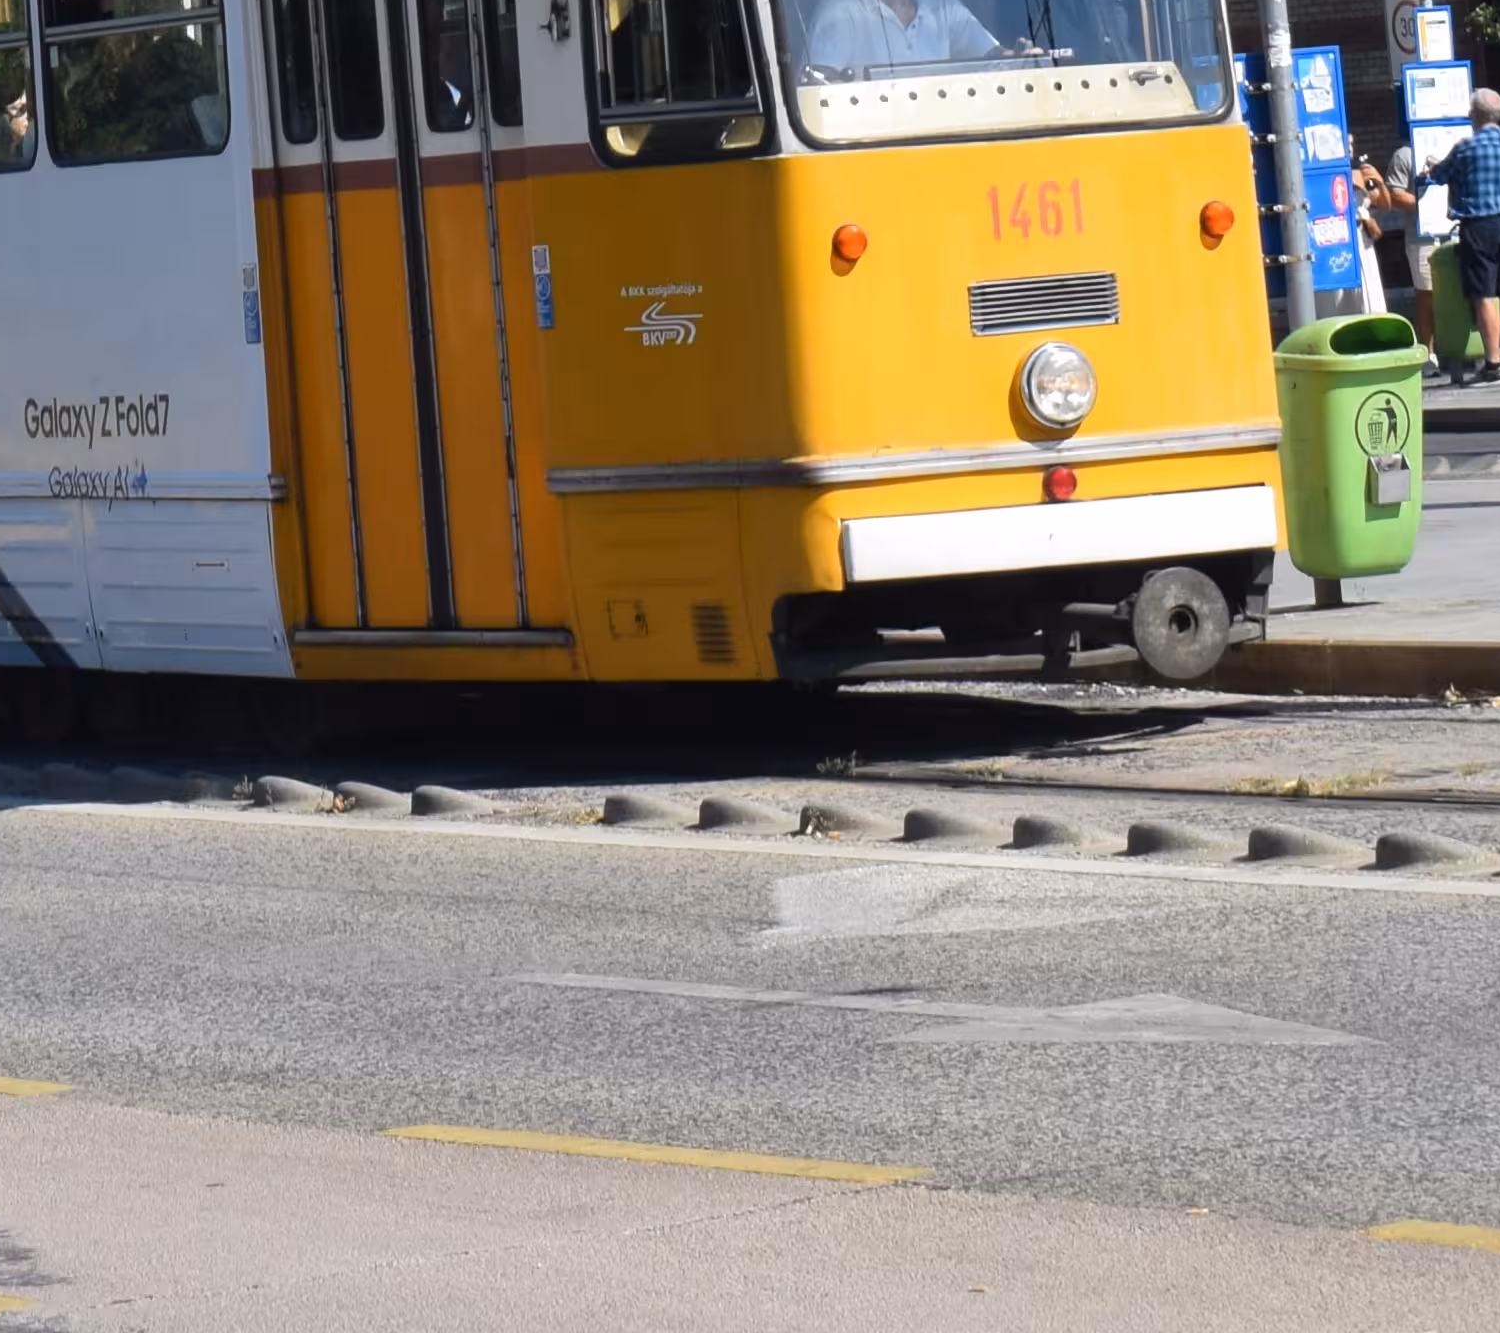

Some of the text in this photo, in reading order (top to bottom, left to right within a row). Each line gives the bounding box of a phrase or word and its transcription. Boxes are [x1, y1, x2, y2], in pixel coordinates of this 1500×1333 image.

[986, 176, 1085, 242] 1461
[24, 393, 170, 450] Galaxy Z Fold7
[48, 464, 129, 512] Galaxy AI
